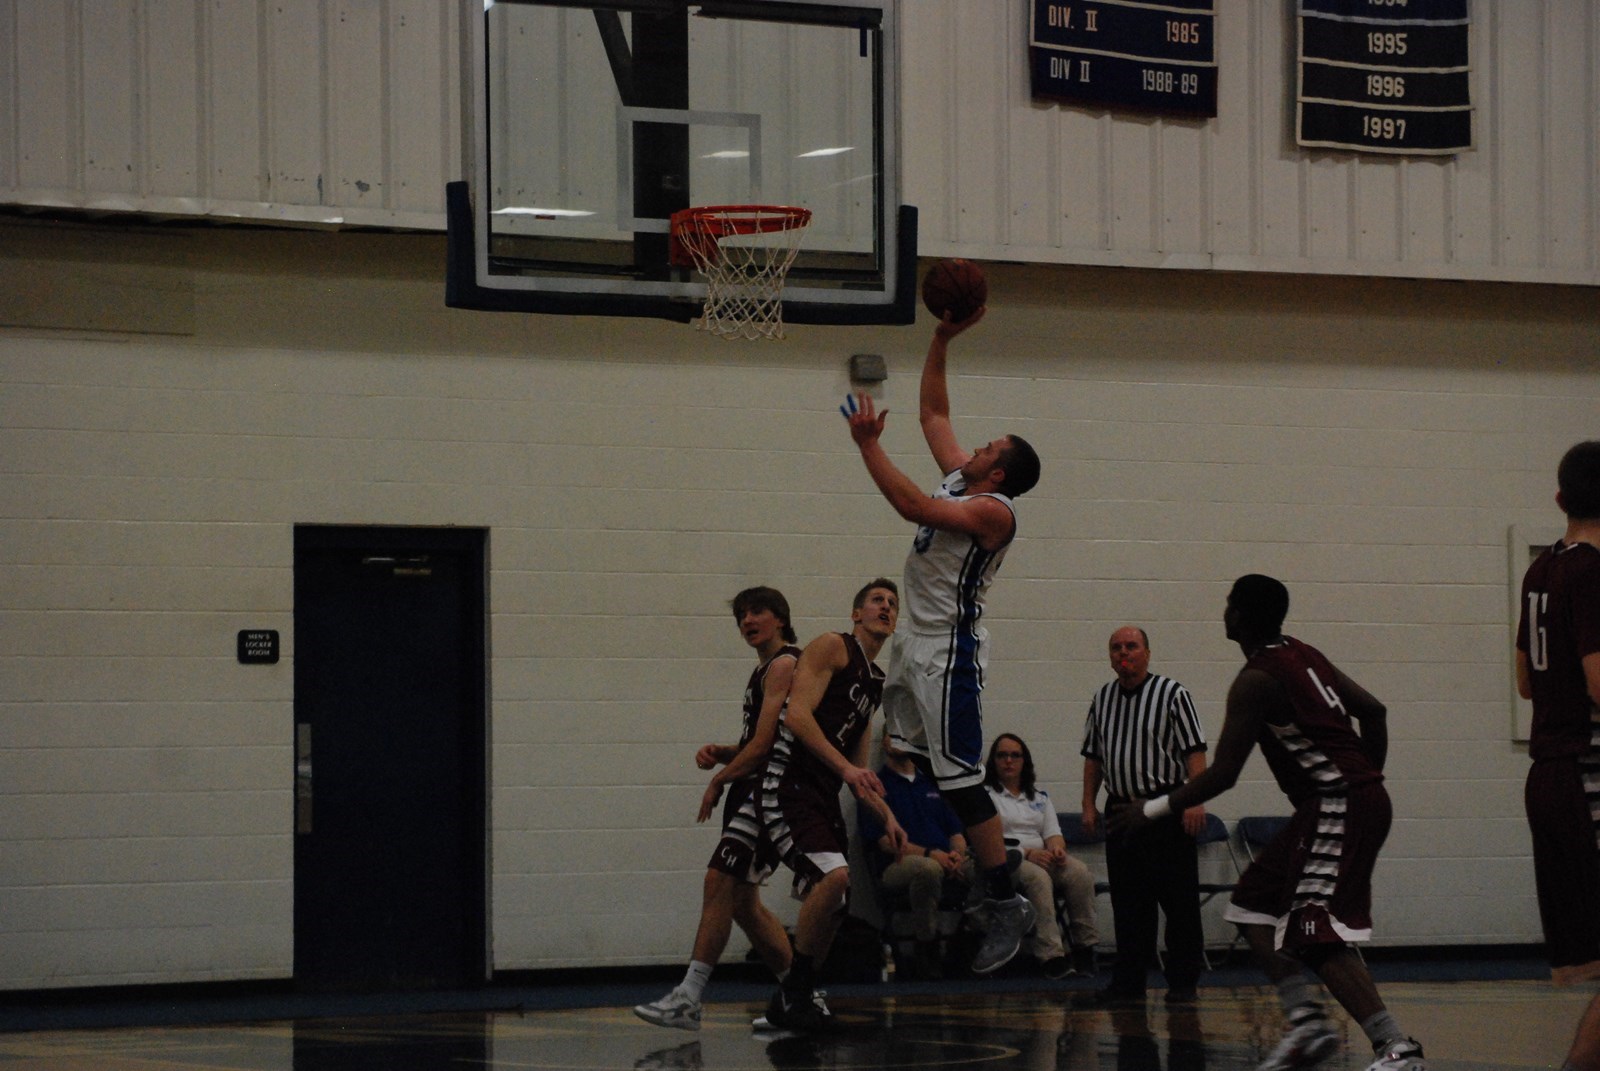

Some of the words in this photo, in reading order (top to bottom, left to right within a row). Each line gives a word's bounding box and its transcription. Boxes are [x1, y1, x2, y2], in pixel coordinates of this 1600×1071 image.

[1048, 5, 1075, 30] DIV.
[1085, 10, 1099, 32] II
[1166, 20, 1200, 45] 1985
[1367, 32, 1408, 56] 1995
[1050, 56, 1071, 80] DIV
[1079, 60, 1091, 83] II
[1366, 74, 1406, 99] 1996
[1363, 115, 1407, 141] 1997
[1306, 666, 1347, 717] 4
